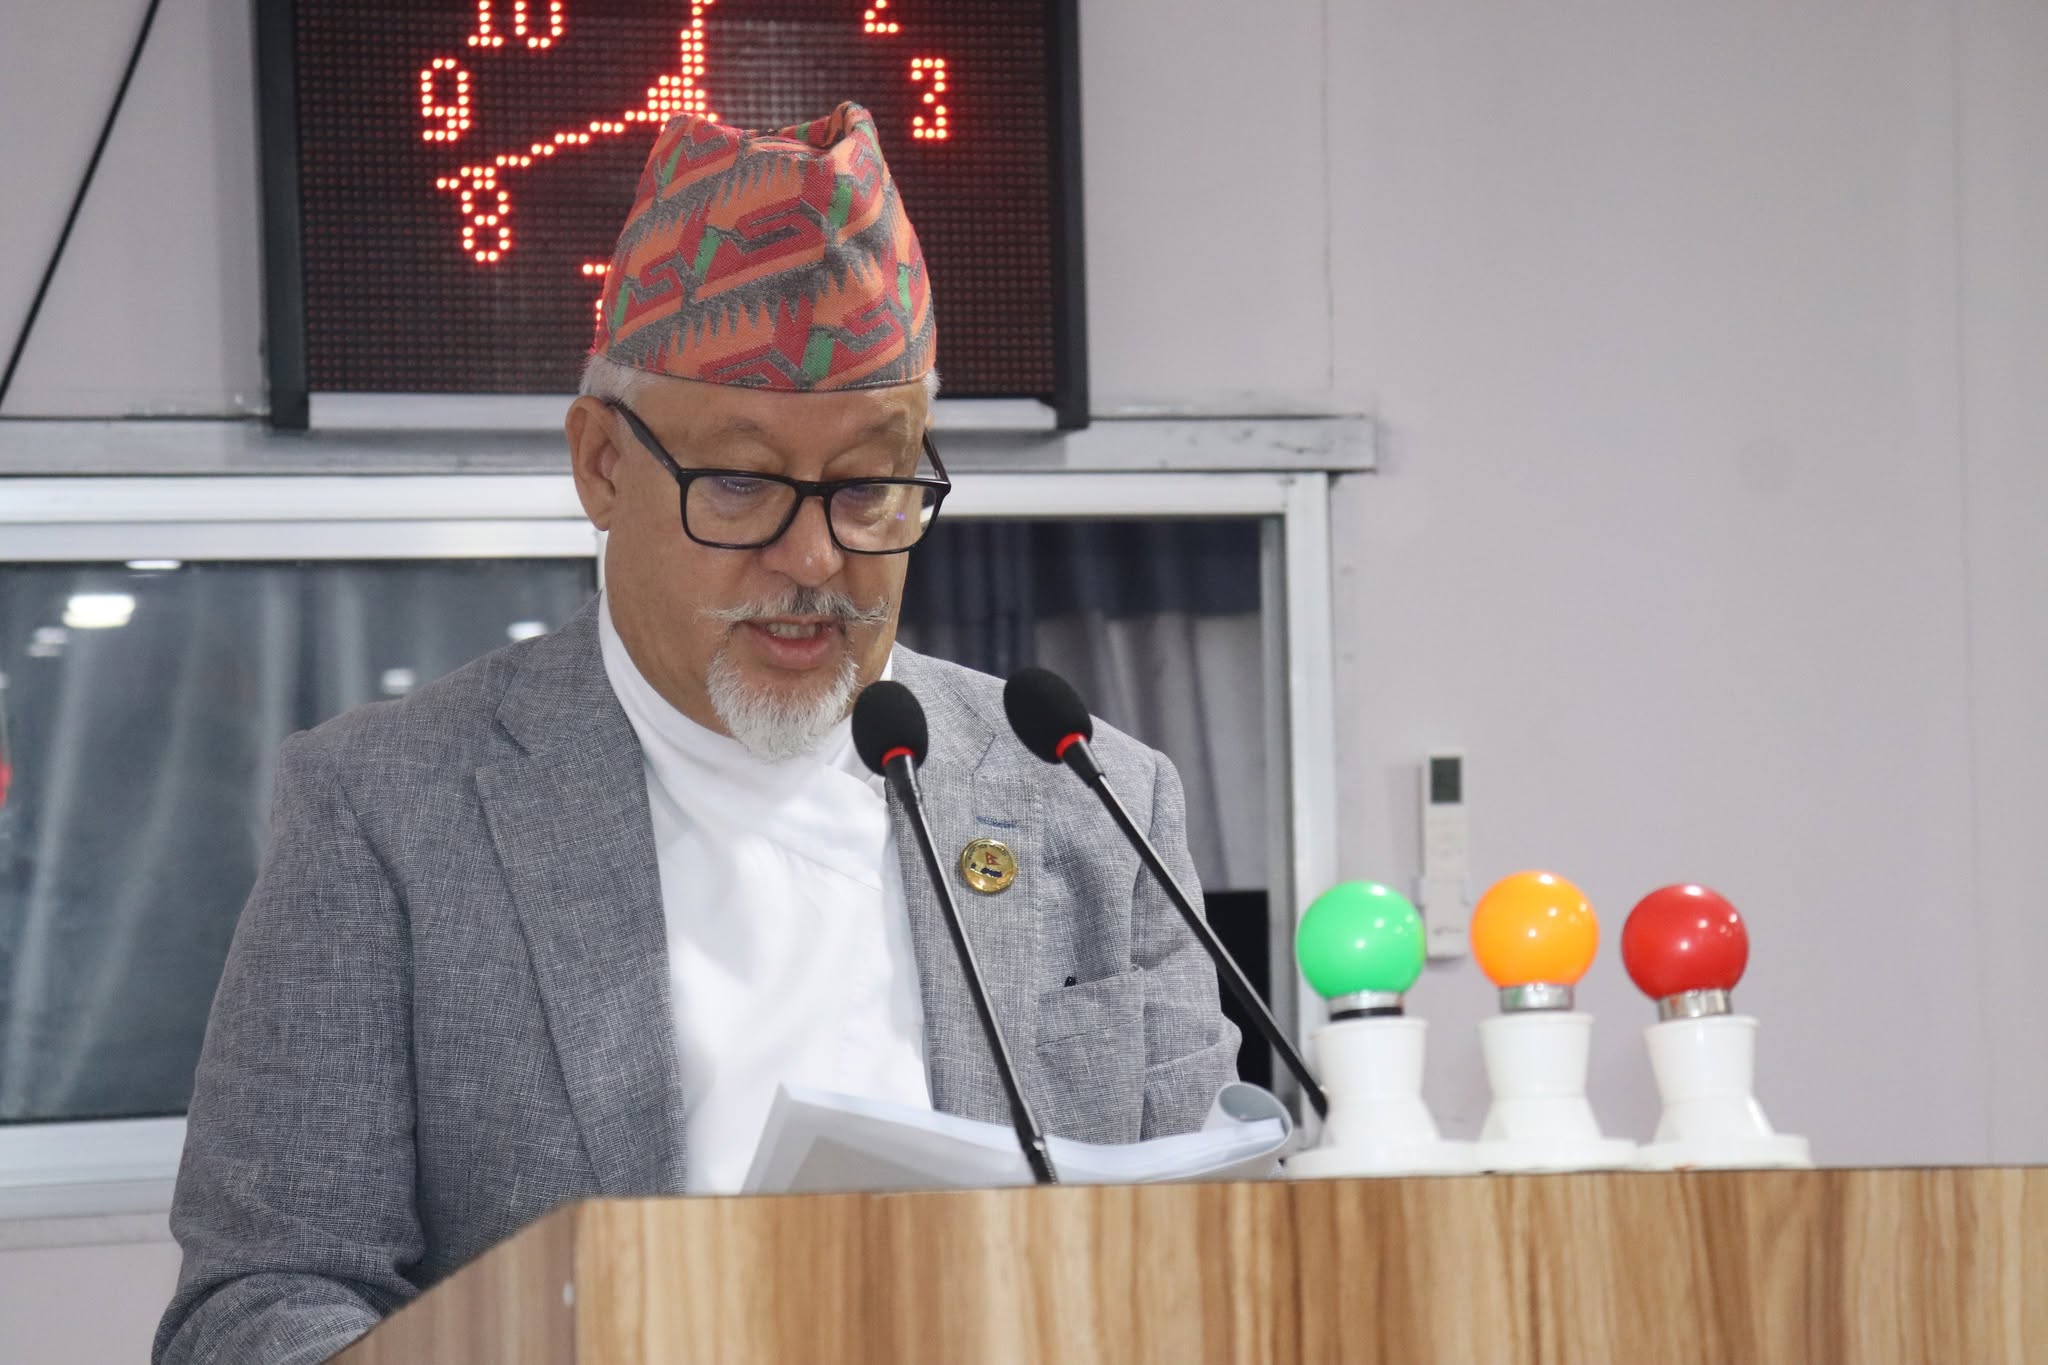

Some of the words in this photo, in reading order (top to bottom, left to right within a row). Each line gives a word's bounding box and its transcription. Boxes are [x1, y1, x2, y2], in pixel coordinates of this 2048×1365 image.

[421, 58, 470, 141] 9
[911, 58, 947, 139] 3
[461, 179, 510, 262] 8
